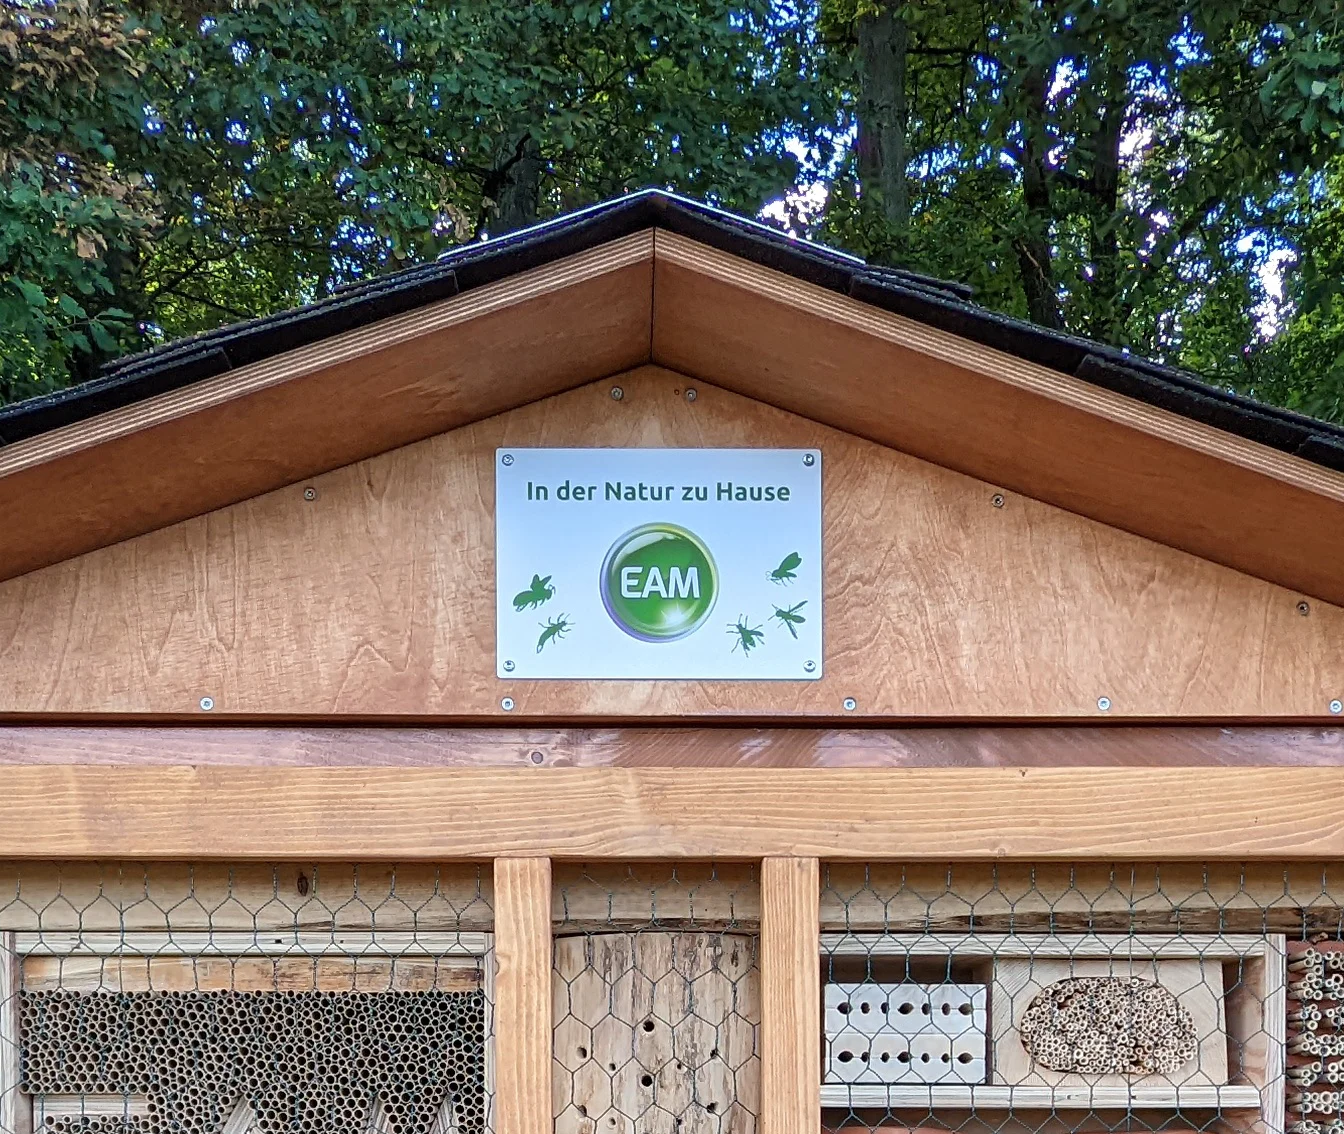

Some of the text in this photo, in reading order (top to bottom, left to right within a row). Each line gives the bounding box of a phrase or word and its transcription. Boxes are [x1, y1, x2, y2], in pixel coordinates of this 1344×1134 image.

[526, 480, 791, 501] In der Natur zu Hause
[620, 566, 701, 599] EAM
